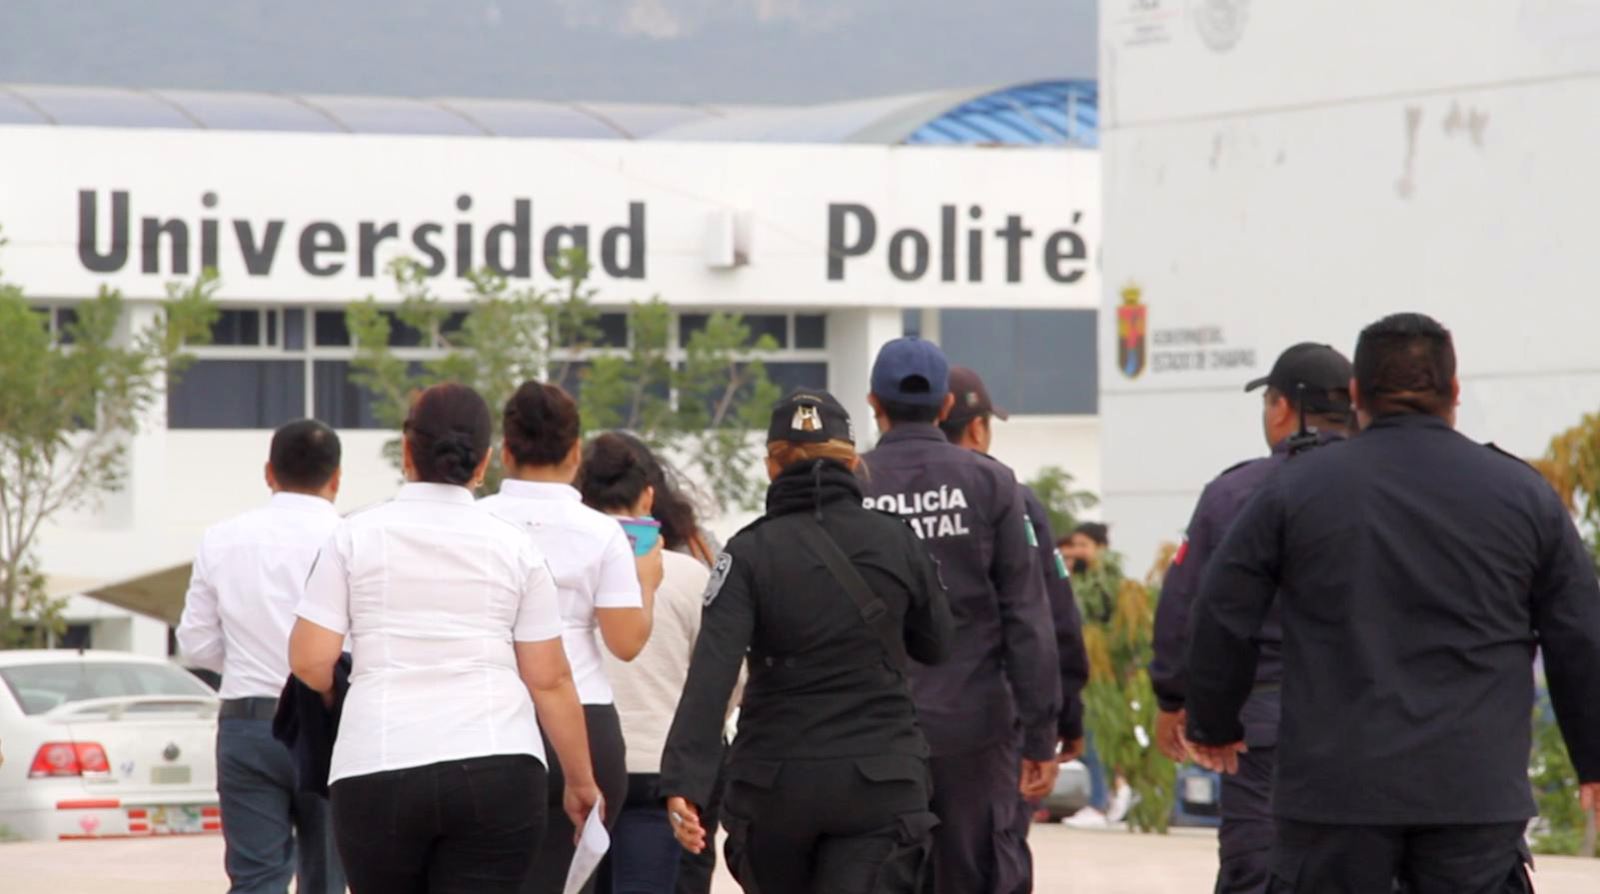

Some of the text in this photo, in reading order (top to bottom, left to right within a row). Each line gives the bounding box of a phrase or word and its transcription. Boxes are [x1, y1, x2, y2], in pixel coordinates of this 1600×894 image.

[77, 189, 1102, 284] Universidad Polité
[862, 484, 968, 515] POLICÍA
